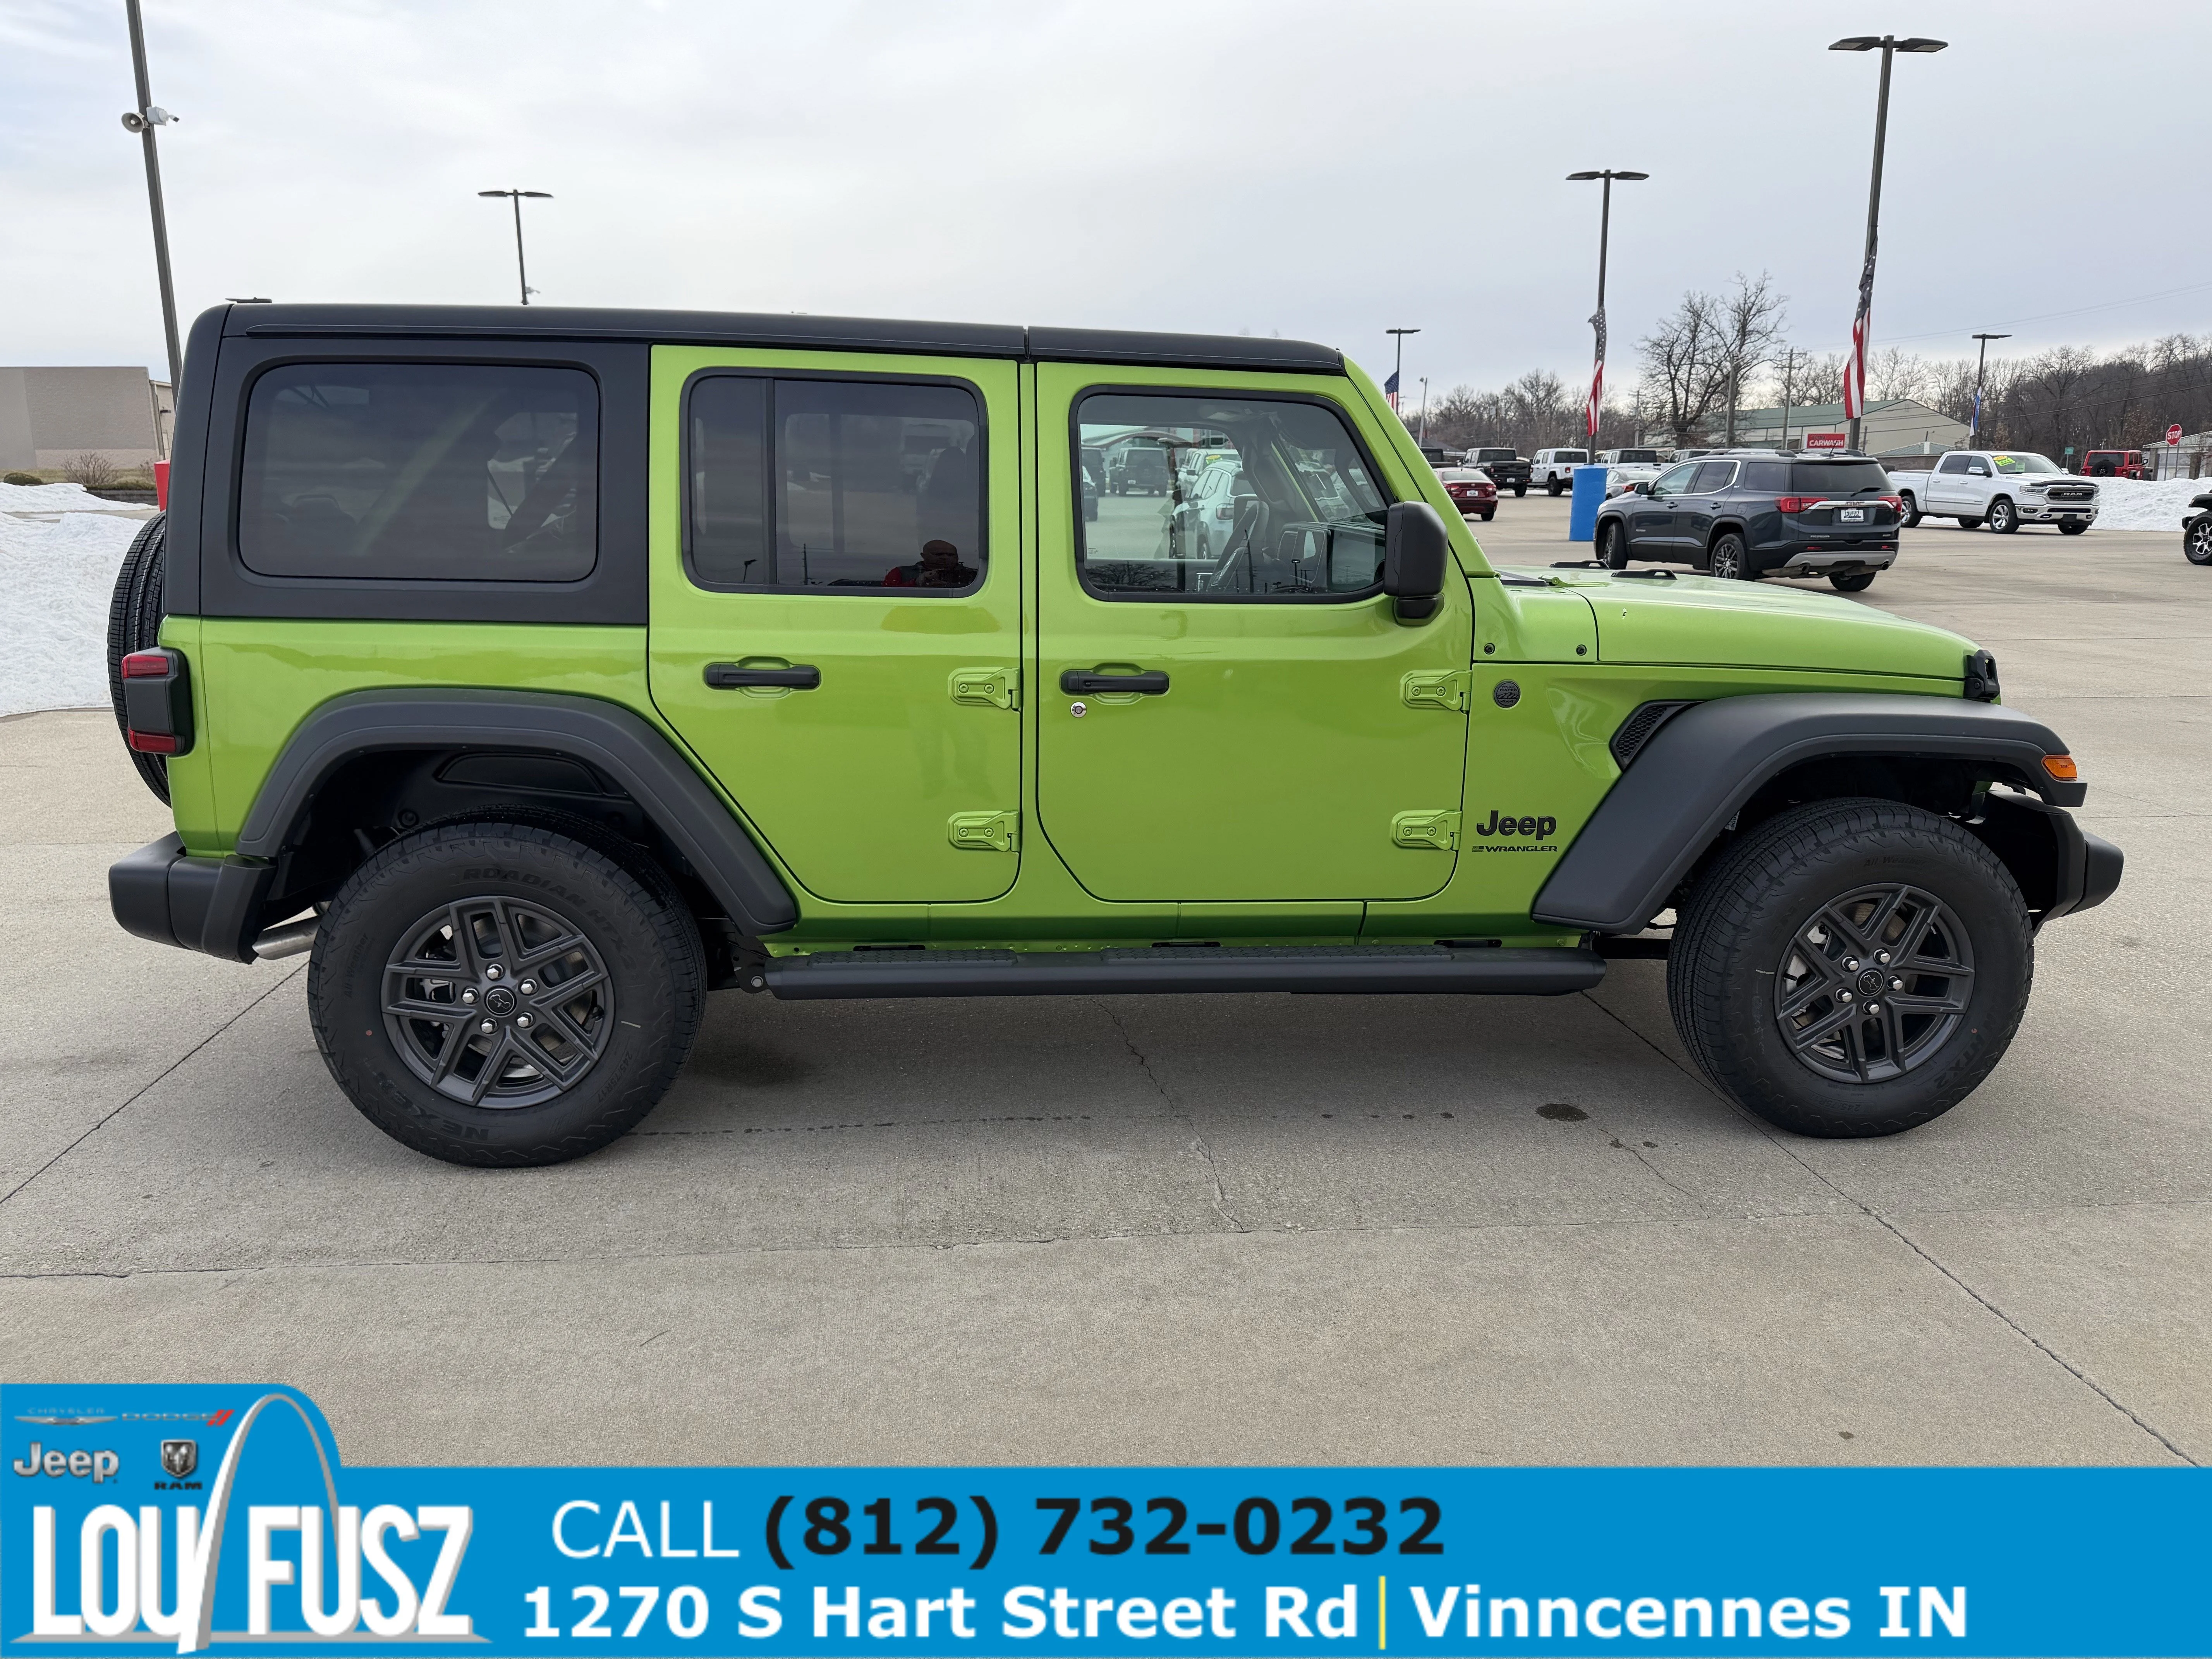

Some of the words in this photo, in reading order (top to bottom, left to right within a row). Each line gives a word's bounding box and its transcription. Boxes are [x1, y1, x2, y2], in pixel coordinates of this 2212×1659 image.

[2167, 430, 2181, 440] STOP
[1476, 810, 1556, 840] Jeep
[462, 868, 587, 907] ROADIAN
[598, 1050, 633, 1104] 245/75R17
